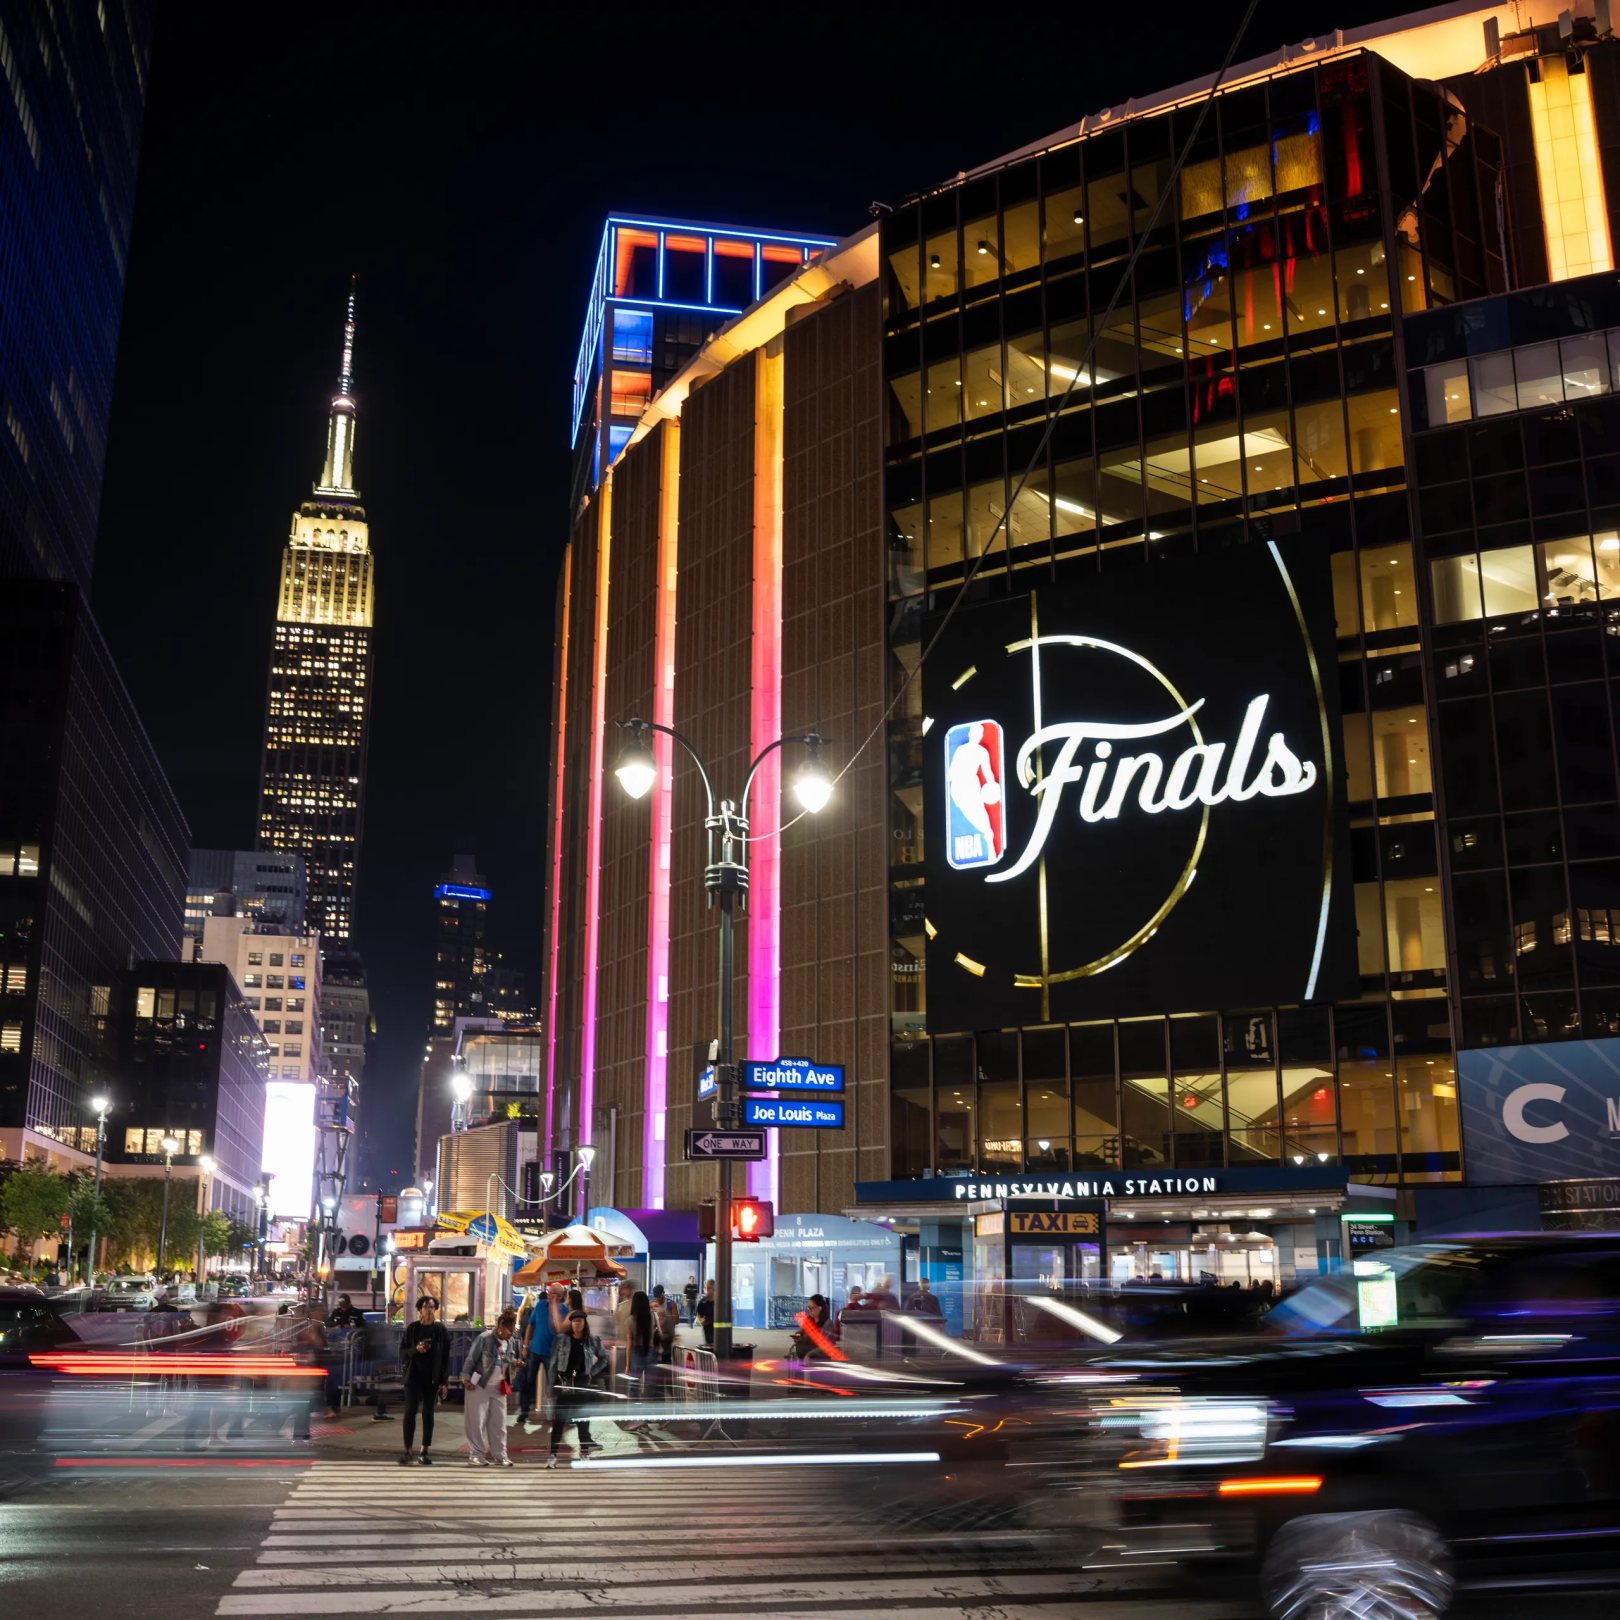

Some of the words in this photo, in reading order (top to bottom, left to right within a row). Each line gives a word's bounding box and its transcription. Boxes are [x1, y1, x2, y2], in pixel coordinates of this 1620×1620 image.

[984, 693, 1317, 882] Finals
[955, 833, 983, 861] NBA
[753, 1067, 801, 1086] Eighth
[805, 1070, 835, 1085] Ave
[753, 1106, 776, 1119] Joe
[778, 1106, 813, 1121] Louis
[816, 1111, 836, 1121] Plaza
[1502, 1082, 1570, 1144] C
[703, 1139, 723, 1148] ONE
[732, 1139, 753, 1148] WAY
[955, 1181, 1115, 1199] PENNSYLVANIA
[1125, 1177, 1216, 1194] STATION
[796, 1216, 802, 1226] 8
[1014, 1213, 1068, 1232] TAXI
[774, 1228, 795, 1238] PENN
[797, 1227, 825, 1238] PLAZA
